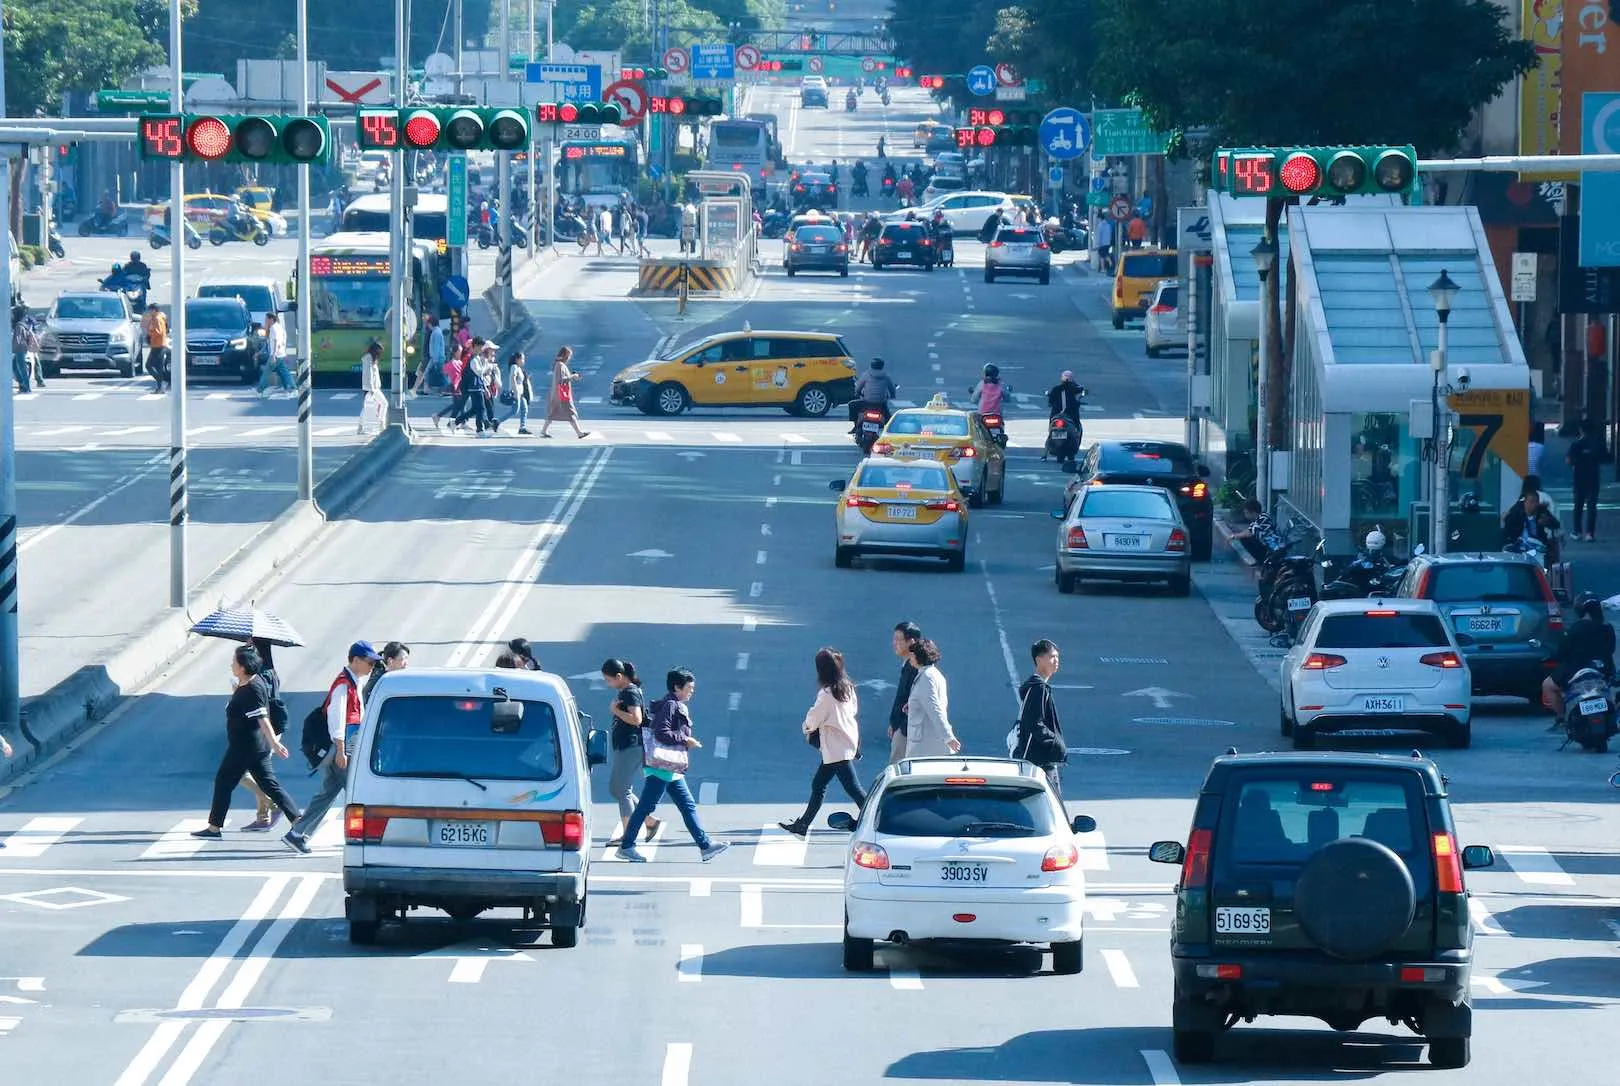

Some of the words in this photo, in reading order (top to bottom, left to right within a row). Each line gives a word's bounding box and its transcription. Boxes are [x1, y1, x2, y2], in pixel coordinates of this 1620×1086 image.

[540, 105, 556, 121] 34
[652, 98, 666, 112] 34
[971, 110, 985, 125] 34
[146, 120, 181, 156] 45
[363, 116, 396, 145] 45
[959, 130, 974, 145] 34
[1235, 157, 1270, 191] 45
[1460, 414, 1504, 478] 7
